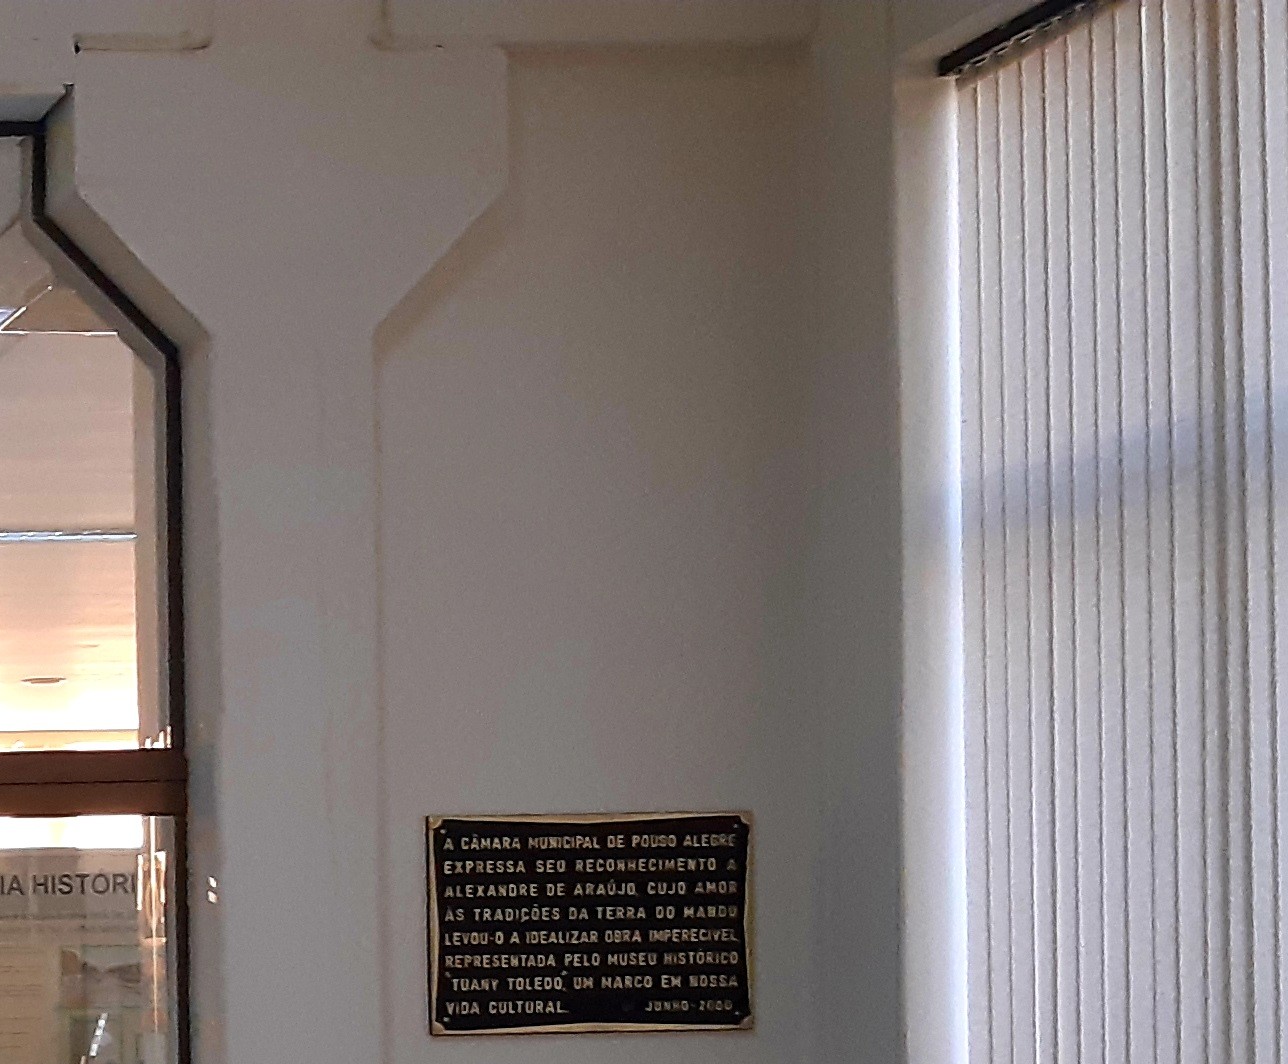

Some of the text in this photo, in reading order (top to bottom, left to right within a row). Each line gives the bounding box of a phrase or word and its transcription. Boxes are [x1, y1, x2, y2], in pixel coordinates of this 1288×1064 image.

[443, 834, 736, 850] A CÂMARA MUNICIPAL DE POUSO ALEGRE
[444, 859, 525, 874] EXPRESSA
[575, 858, 717, 873] RECONHECIMENTO
[726, 858, 737, 872] A
[444, 884, 539, 898] ALEXANDRE
[546, 883, 566, 896] DE
[647, 882, 686, 895] CUJO
[694, 881, 738, 895] AMOR
[474, 904, 560, 923] TRADIÇÕES
[569, 907, 589, 920] DA
[597, 906, 646, 920] TERRA
[655, 906, 675, 919] DO
[444, 932, 504, 946] LEVOU-O
[509, 931, 521, 945] A
[525, 930, 598, 944] IDEALIZAR
[605, 930, 642, 943] OBRA
[445, 954, 556, 968] REPRESENTADA
[565, 953, 600, 967] PELO
[607, 952, 657, 966] MUSEU
[574, 976, 593, 990] UM
[601, 976, 653, 990] MARCO
[661, 975, 682, 989] EM
[689, 974, 739, 988] NOSSA
[446, 1001, 480, 1015] VIDA
